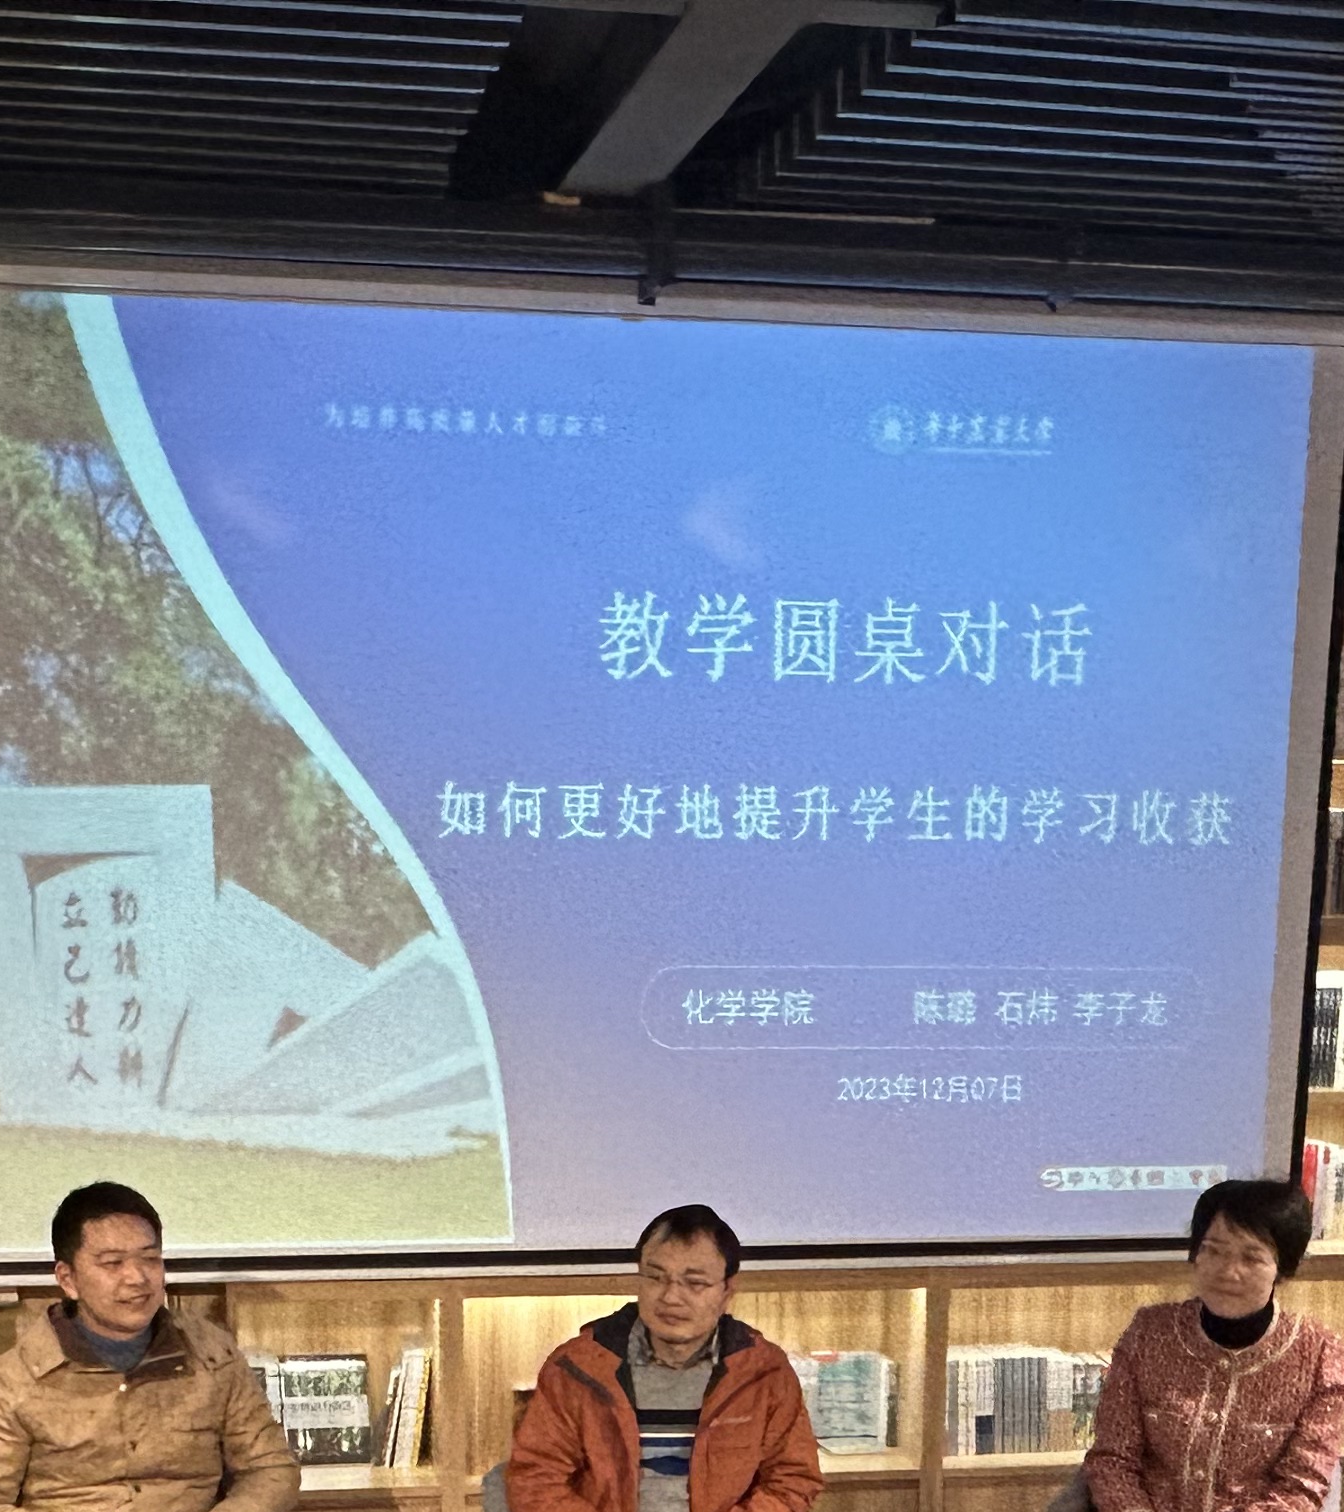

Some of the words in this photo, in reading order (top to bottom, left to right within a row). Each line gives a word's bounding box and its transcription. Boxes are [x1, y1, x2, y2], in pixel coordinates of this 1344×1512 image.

[598, 591, 1092, 687] 教学圆桌对话
[438, 780, 1235, 848] 如何更好地提升学生的学习收获
[681, 987, 816, 1028] 化学学院
[1072, 988, 1170, 1028] 李子龙
[837, 1073, 1025, 1105] 2023年12月07日
